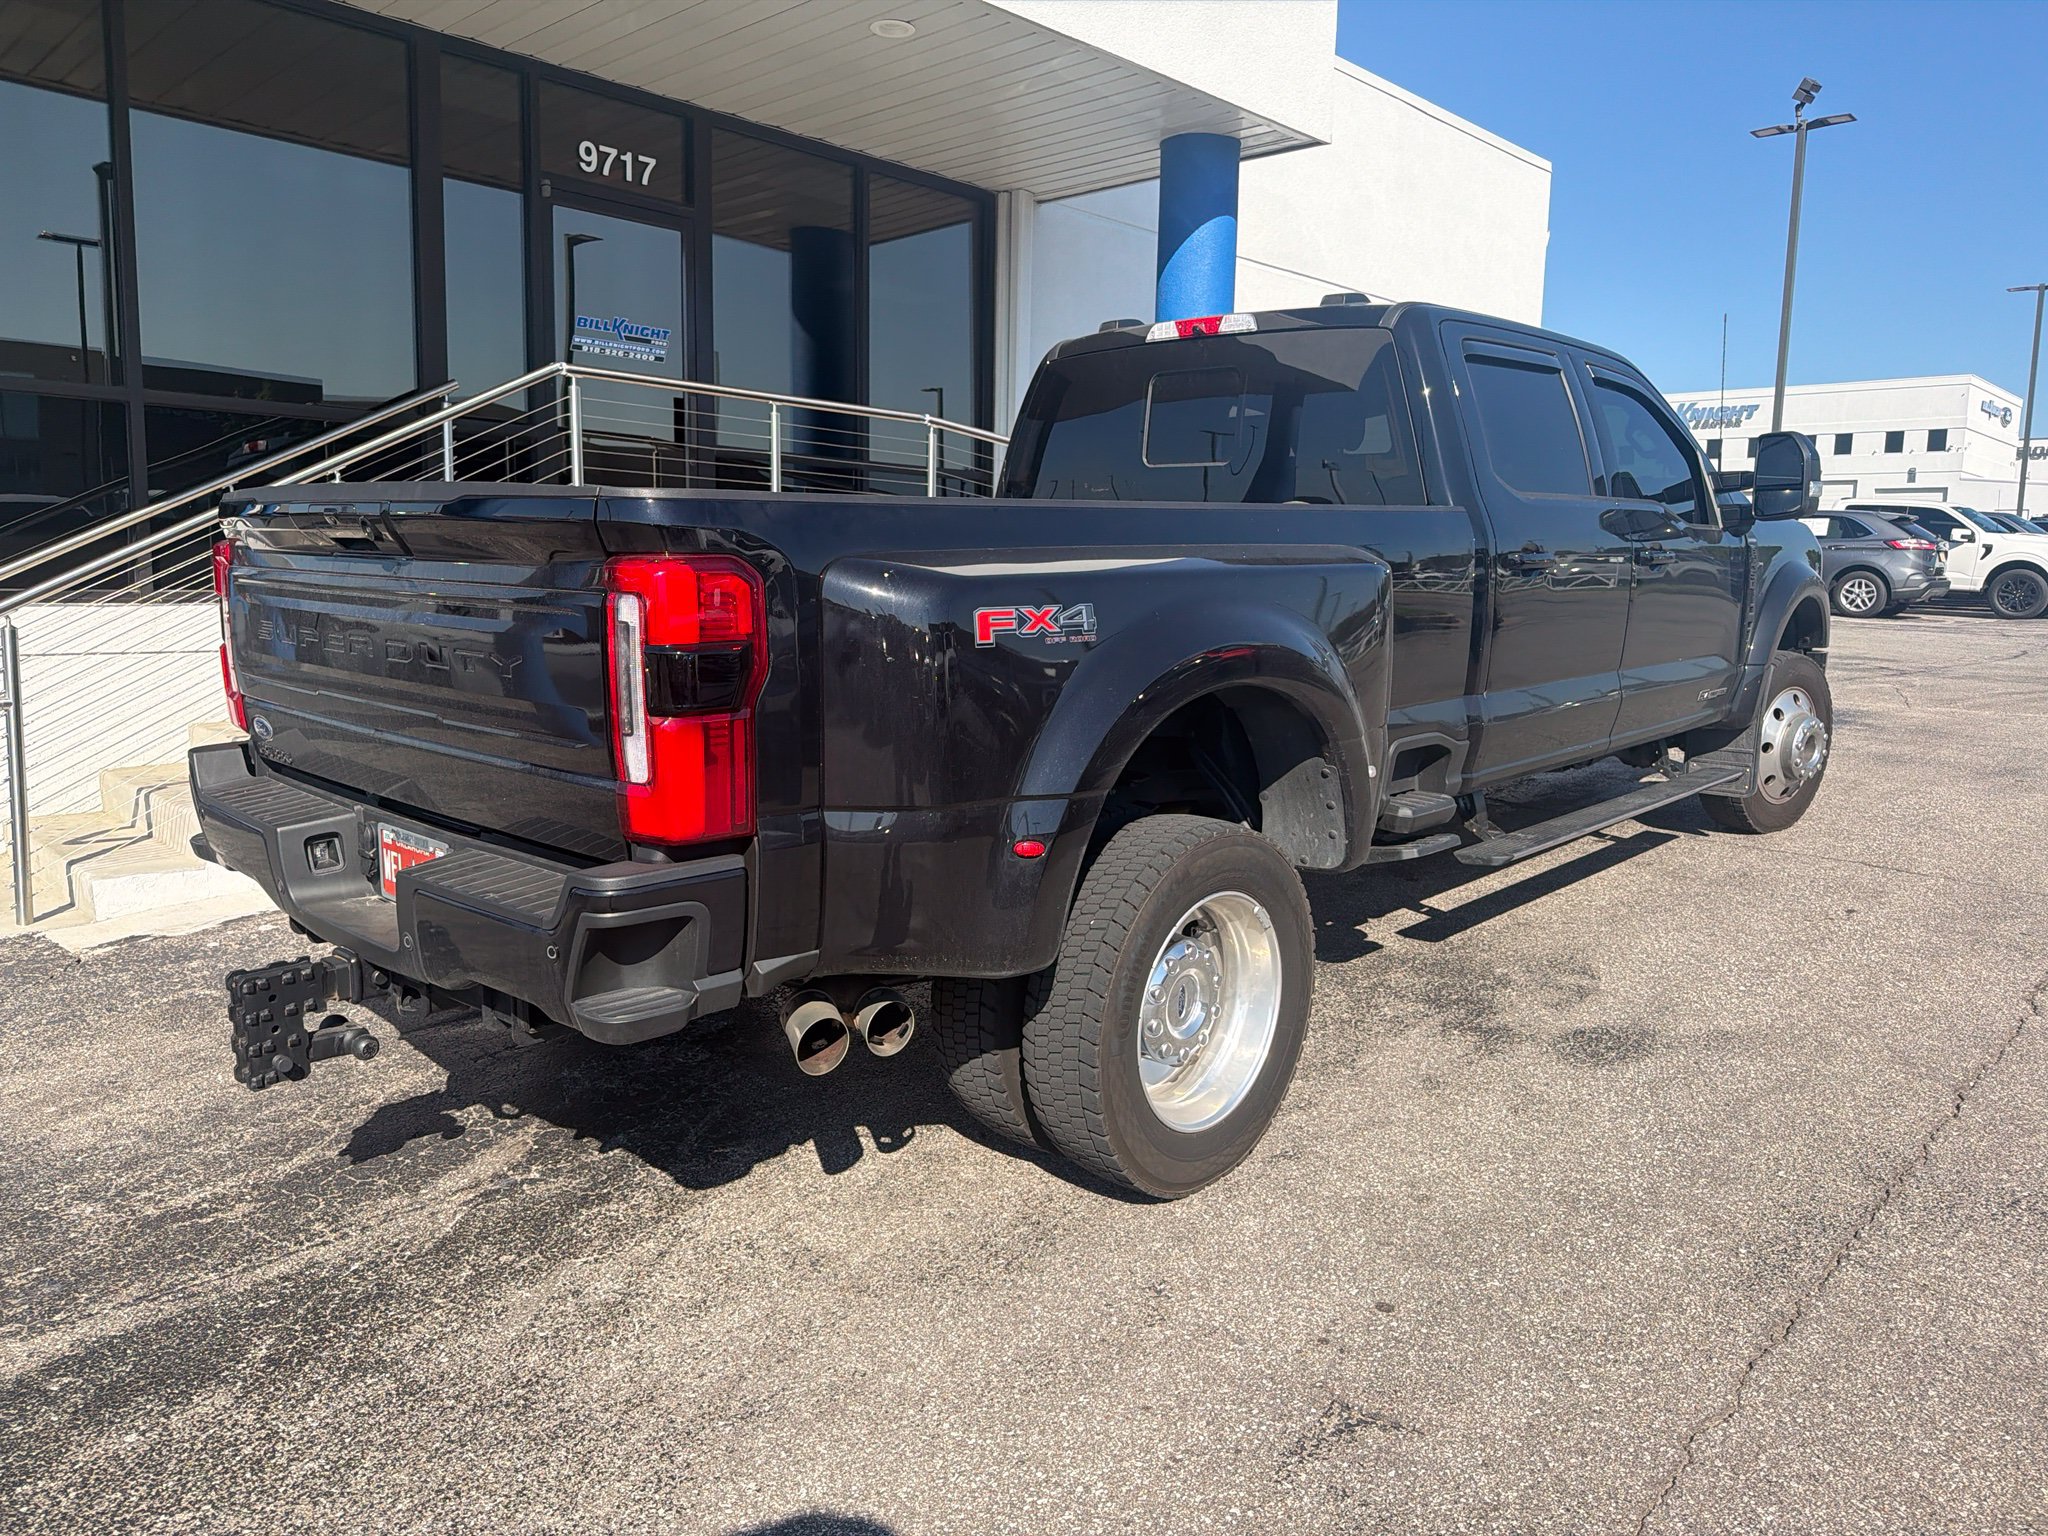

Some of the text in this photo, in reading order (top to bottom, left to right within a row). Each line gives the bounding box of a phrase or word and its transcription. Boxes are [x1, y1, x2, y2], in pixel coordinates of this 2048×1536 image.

[578, 140, 657, 186] 9717
[581, 345, 656, 361] 918-526-2400
[1676, 402, 1760, 426] KNIGHT
[973, 603, 1097, 648] FX4
[257, 619, 524, 679] SUPER DUTY
